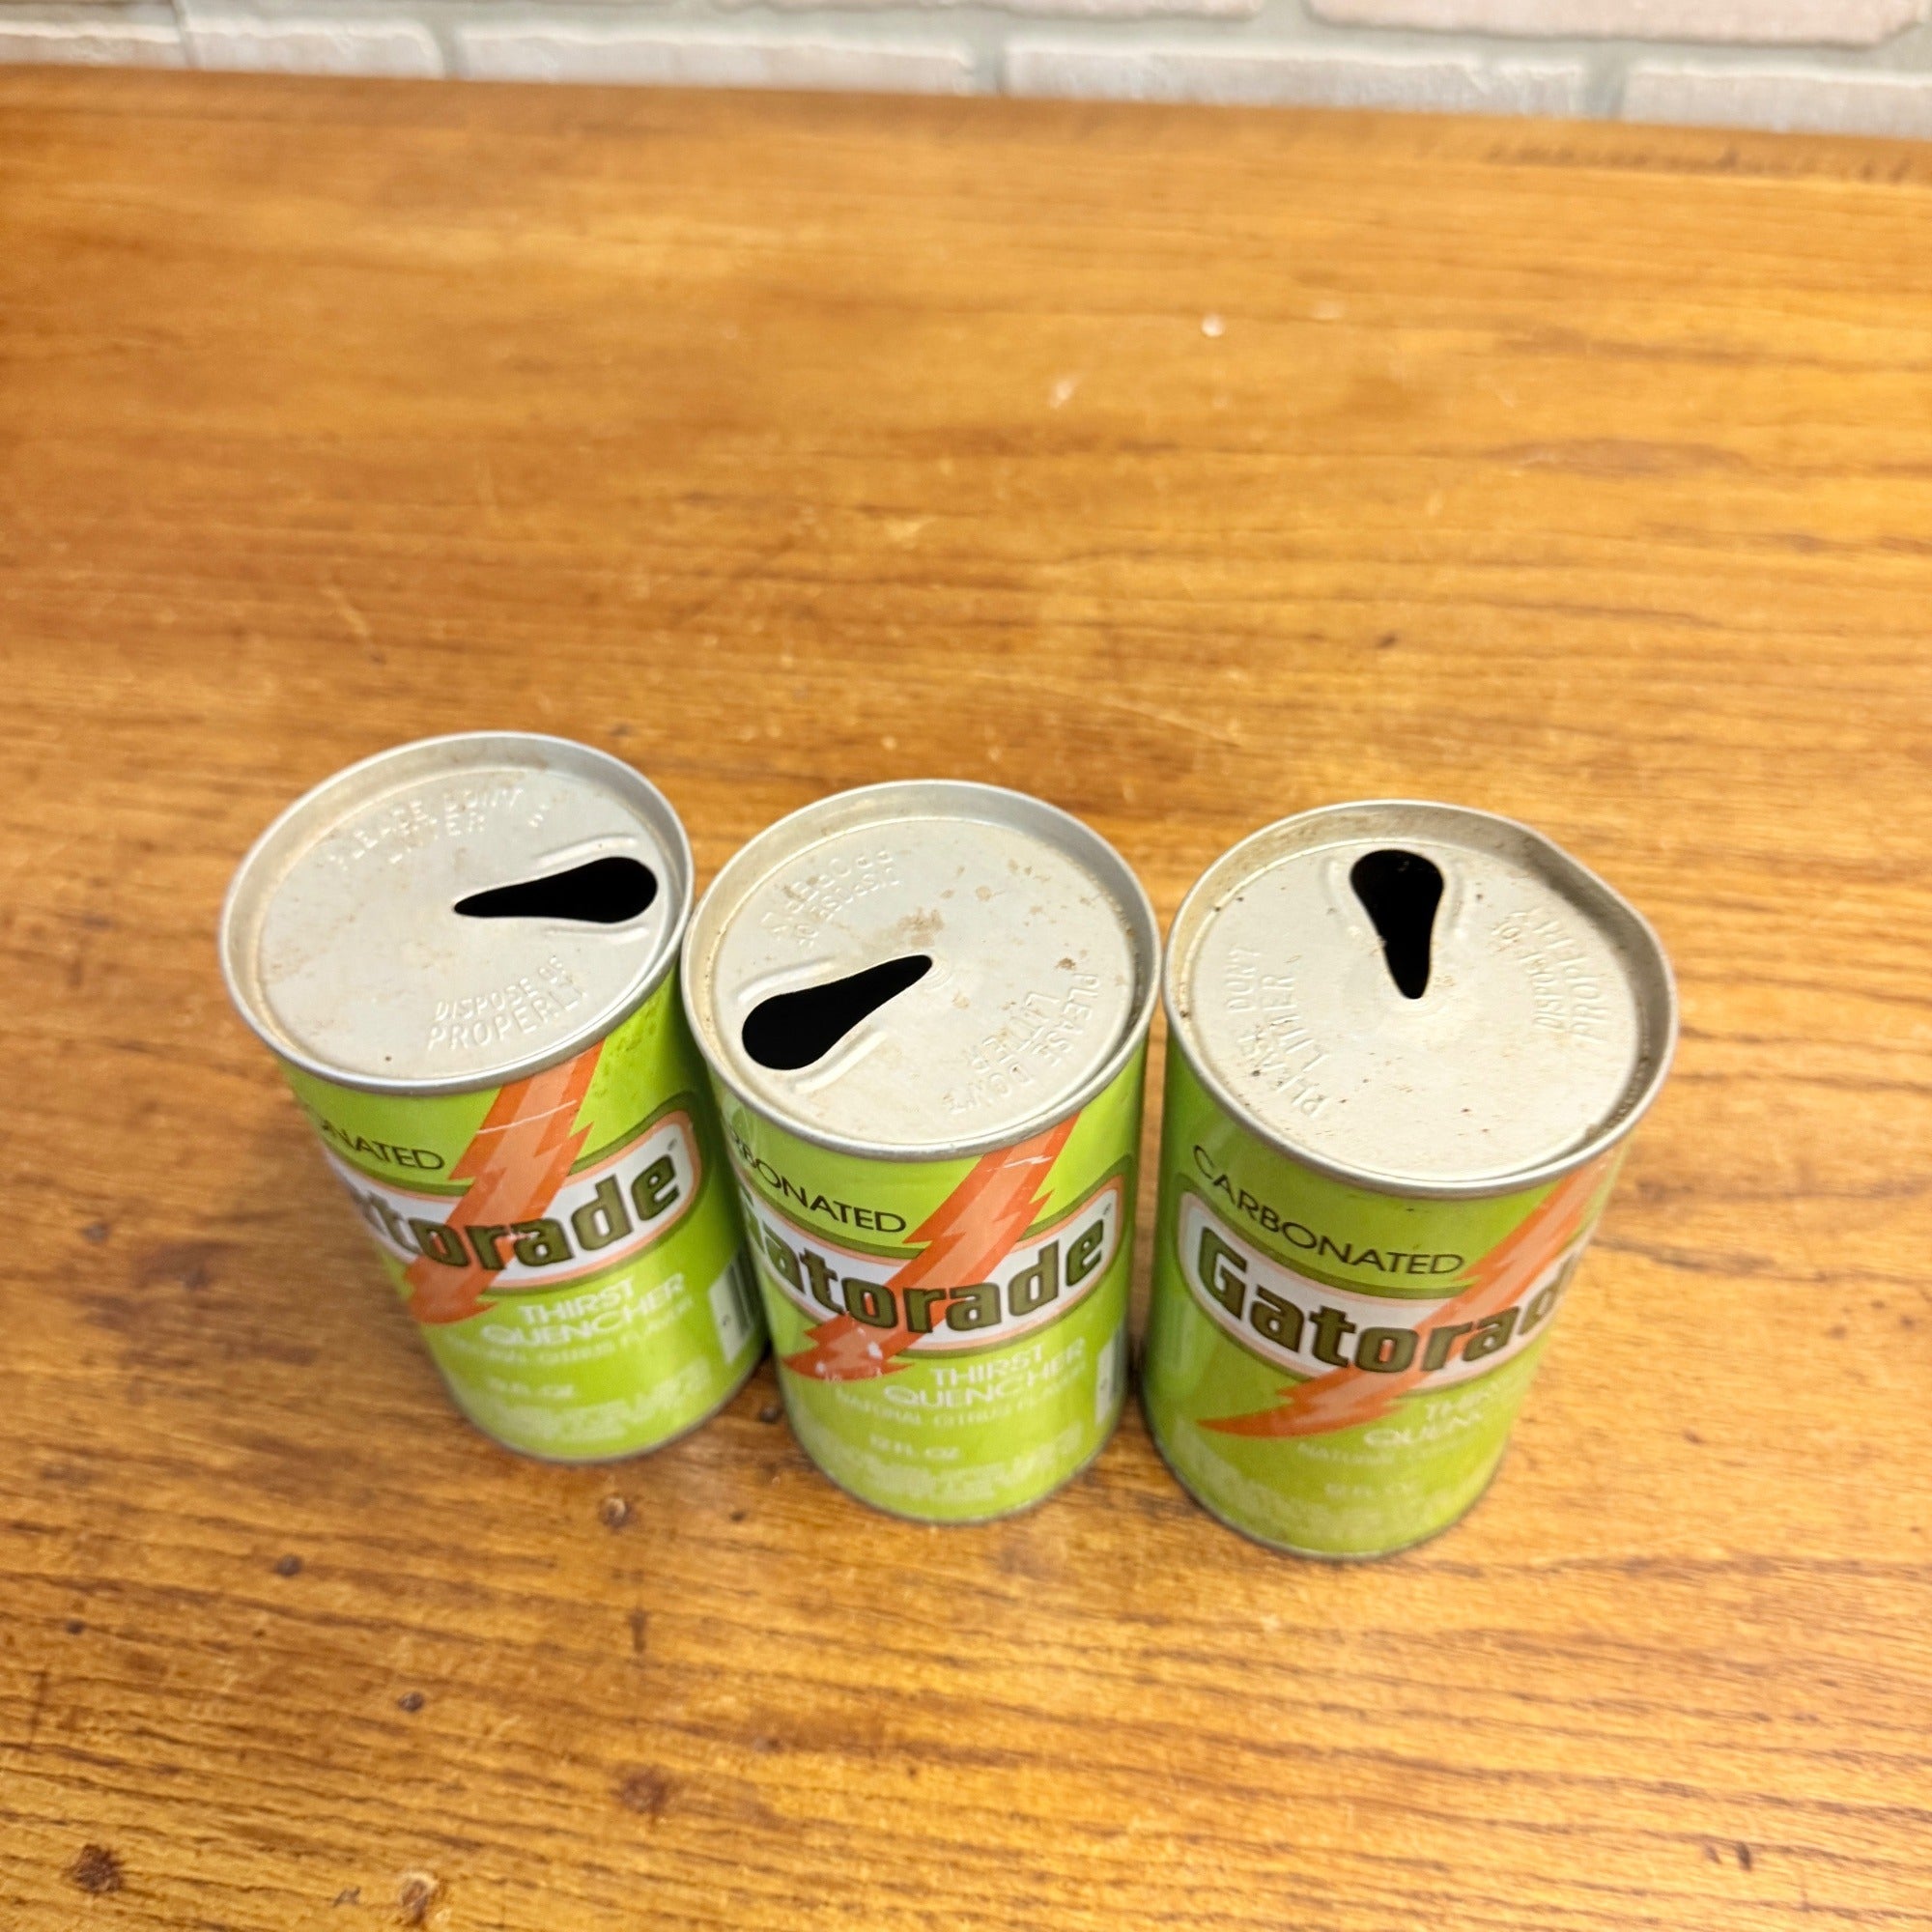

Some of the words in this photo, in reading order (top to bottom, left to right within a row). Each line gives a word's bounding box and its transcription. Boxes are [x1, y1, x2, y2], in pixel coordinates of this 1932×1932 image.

[435, 977, 539, 1022] DISPOSE
[1033, 972, 1099, 1067] PLEASE
[1192, 1144, 1464, 1275] CARBONATED
[479, 1272, 685, 1346] QUENCHER
[518, 1276, 636, 1324] THIRST
[1197, 1225, 1576, 1375] Gatorad
[882, 1336, 1087, 1409] QUENCHER
[929, 1343, 1043, 1387] THIRST
